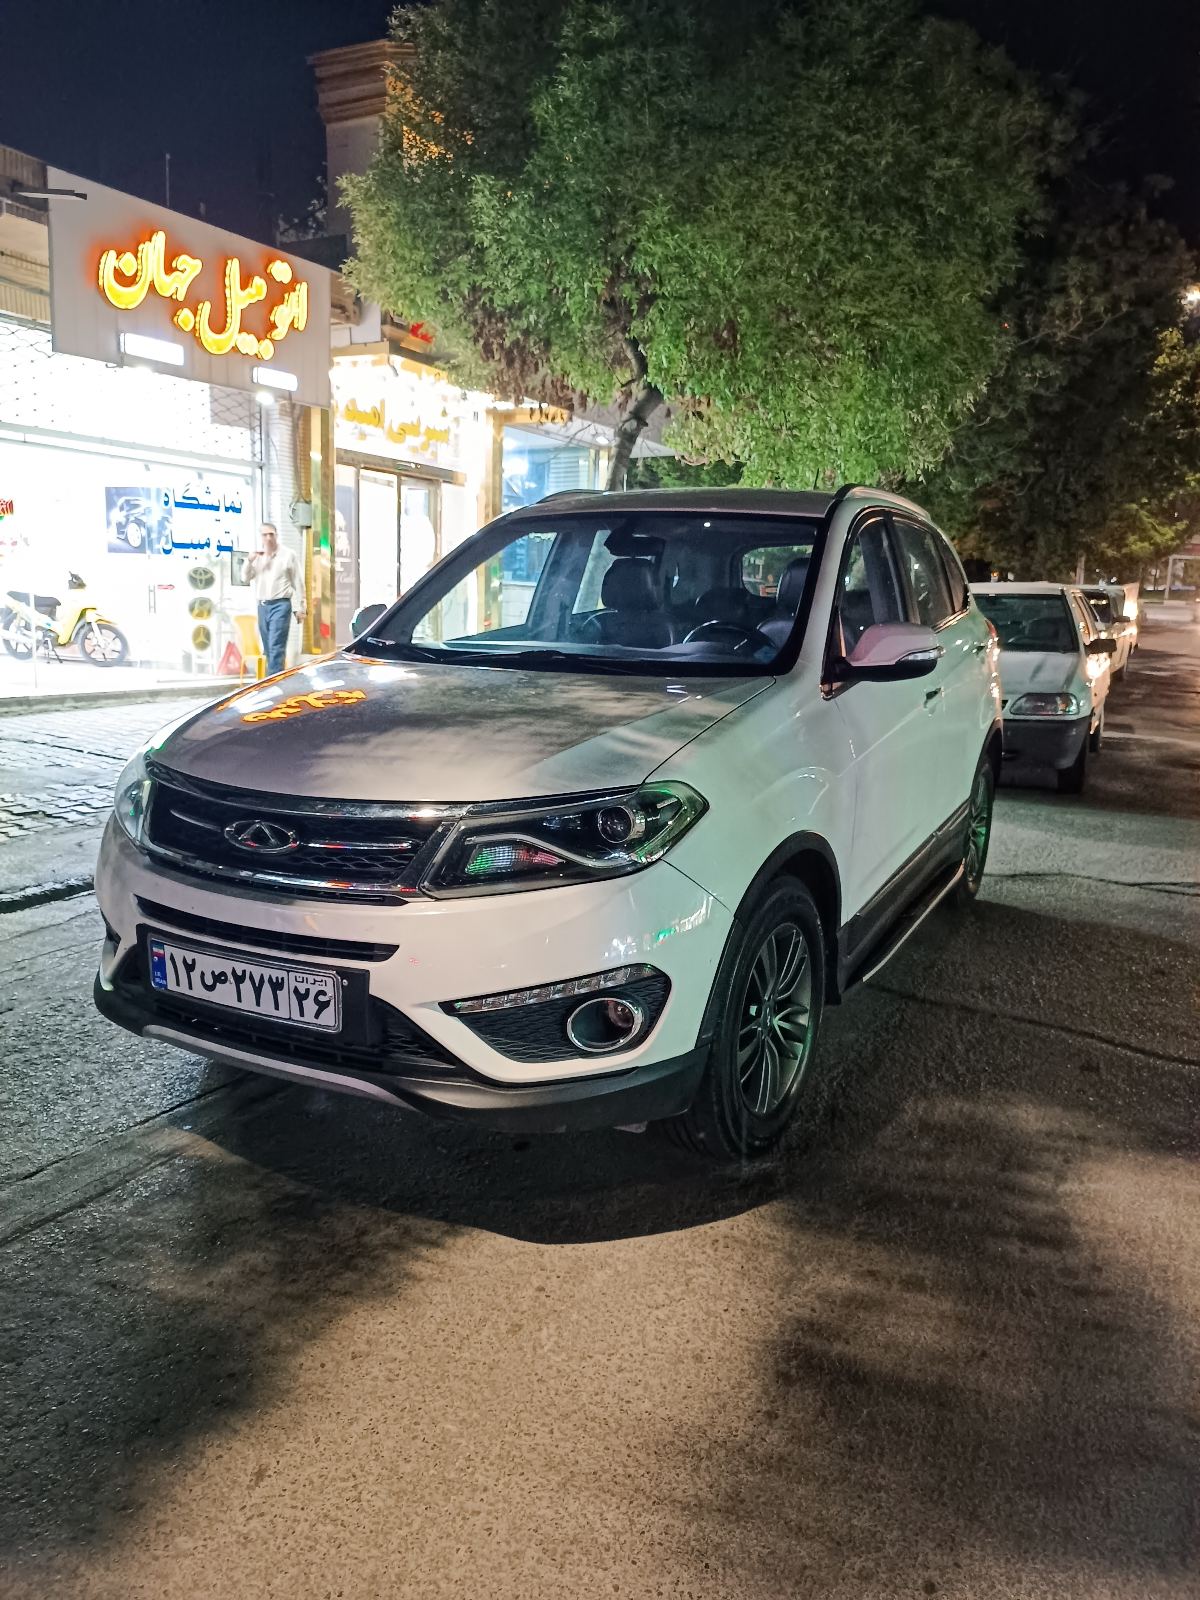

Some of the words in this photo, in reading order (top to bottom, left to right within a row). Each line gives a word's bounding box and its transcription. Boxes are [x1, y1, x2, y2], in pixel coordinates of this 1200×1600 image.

[195, 257, 308, 361] اتومبیل
[163, 482, 243, 522] نمایشگاه
[160, 528, 240, 560] اتومبیل
[294, 974, 328, 988] ایران
[292, 984, 331, 1020] ۲۶
